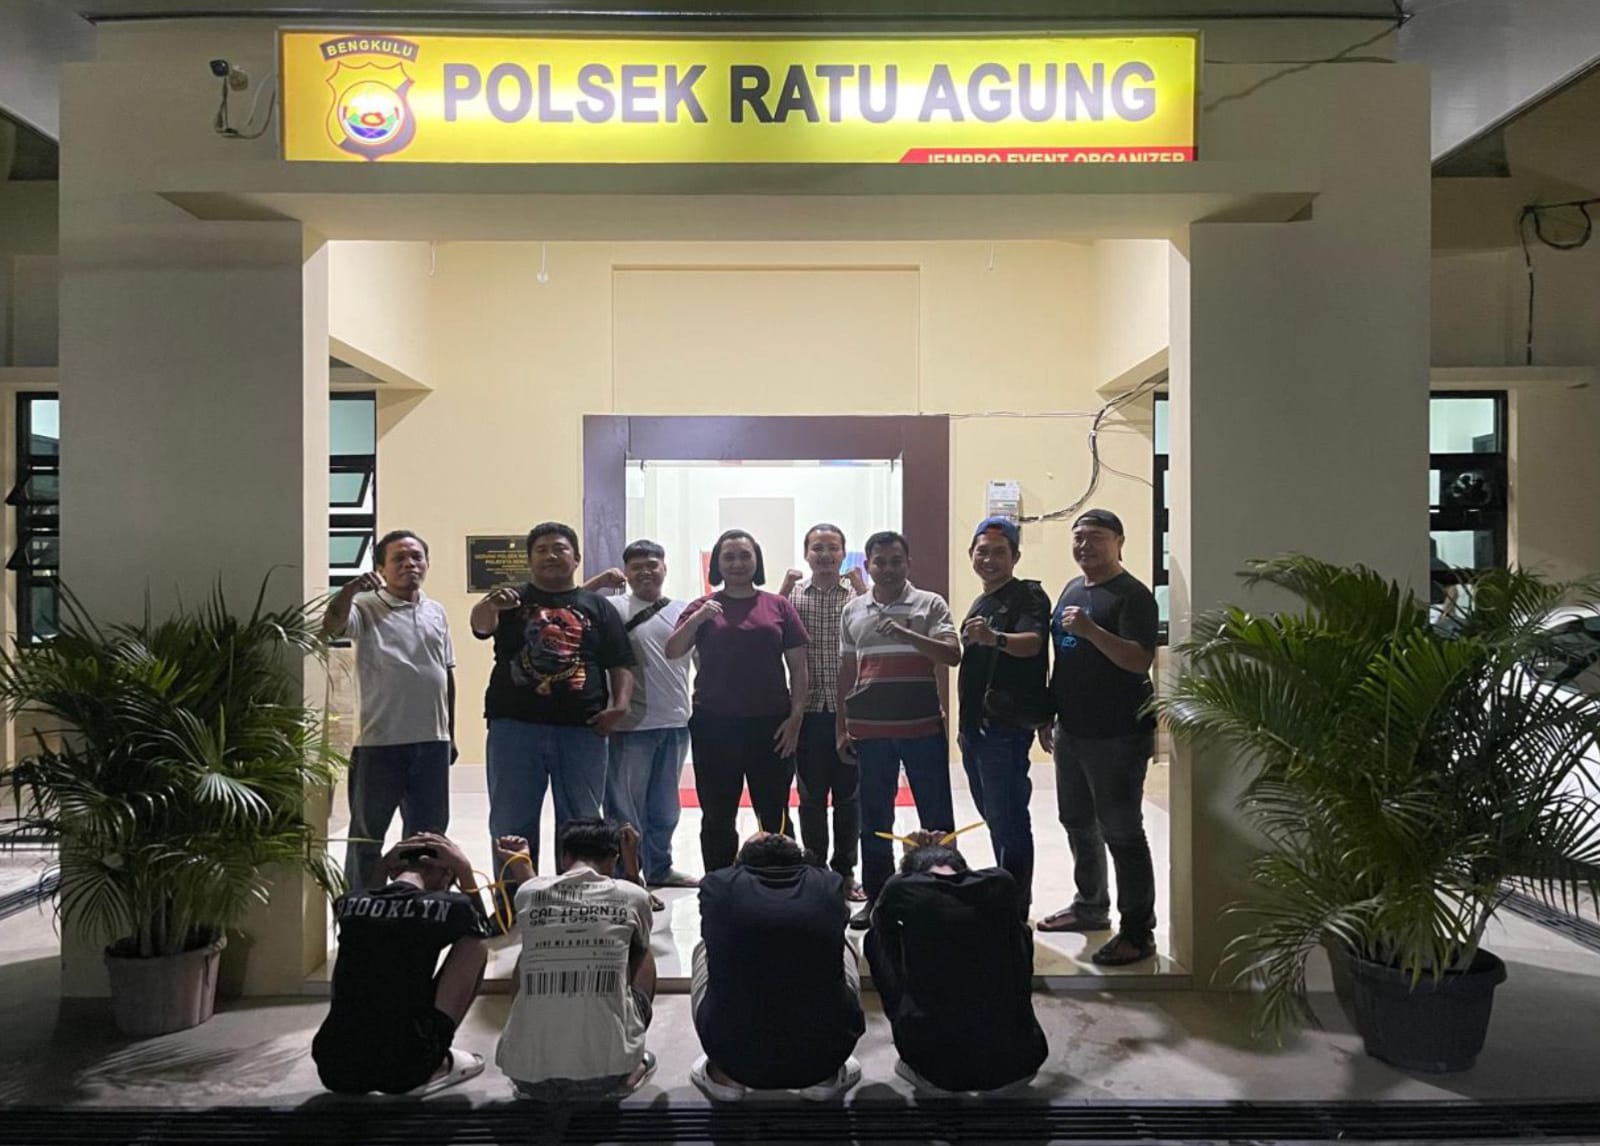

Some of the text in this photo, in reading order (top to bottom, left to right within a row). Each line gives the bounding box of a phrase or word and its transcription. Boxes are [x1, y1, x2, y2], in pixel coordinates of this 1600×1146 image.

[325, 40, 413, 57] BENGKULU
[443, 61, 1156, 123] POLSEK RATU AGUNG
[335, 897, 450, 922] BROOKLYN
[529, 905, 627, 919] CALIFORNIA
